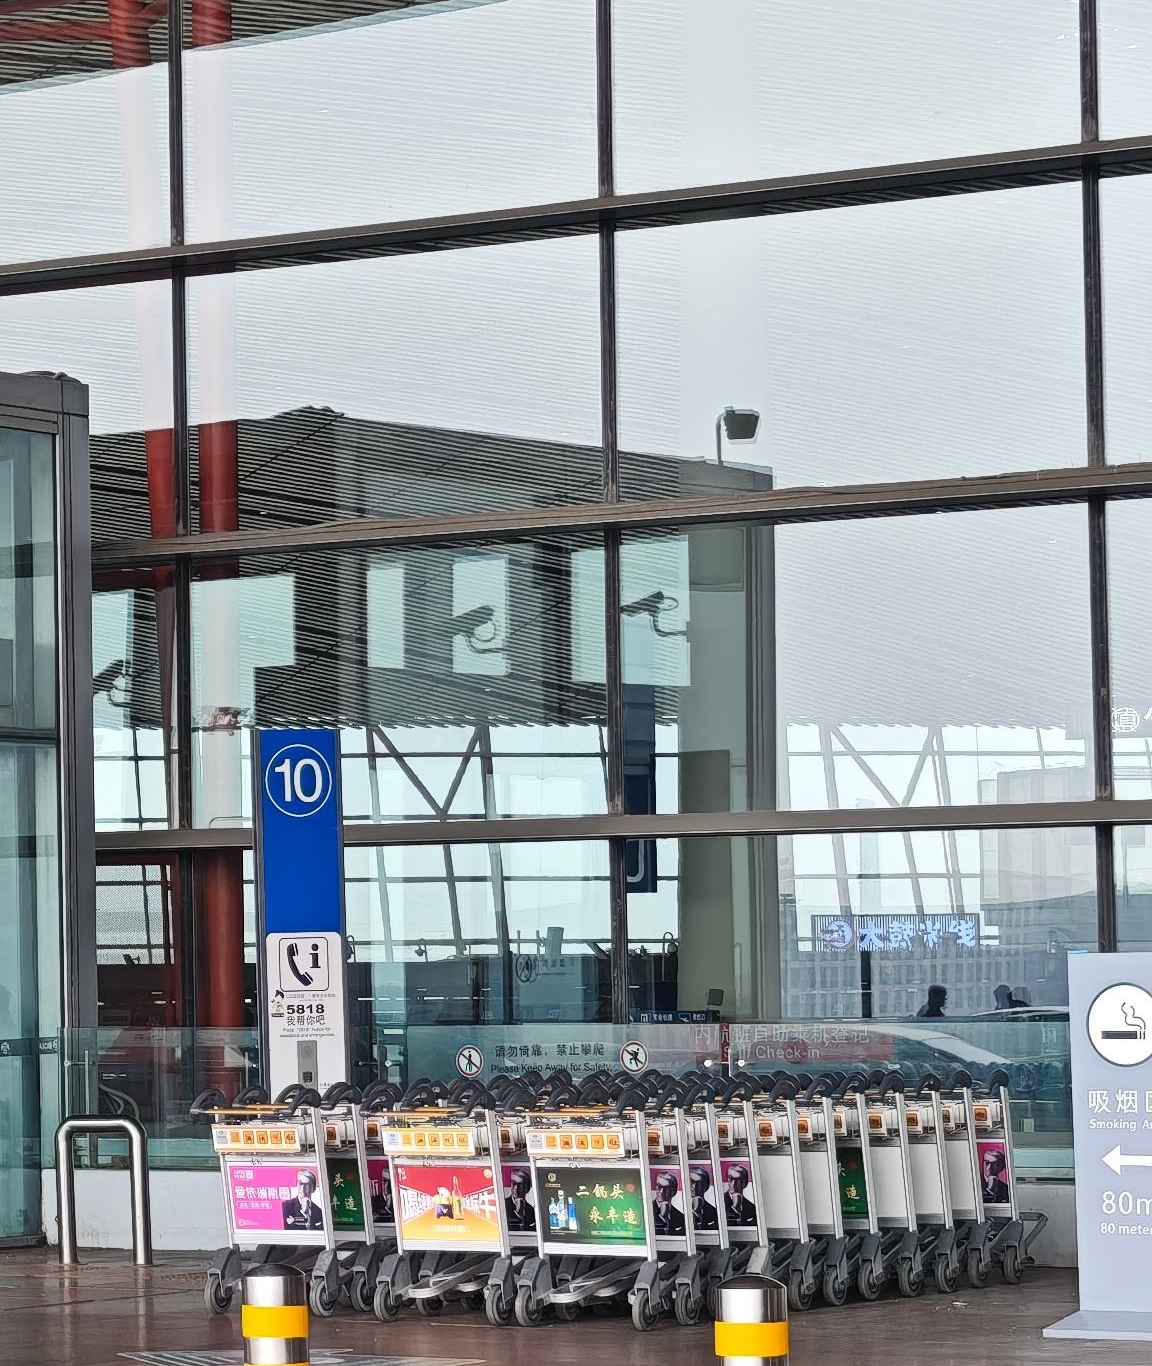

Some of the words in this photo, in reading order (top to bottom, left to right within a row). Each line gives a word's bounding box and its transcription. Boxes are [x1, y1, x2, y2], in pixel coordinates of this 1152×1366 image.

[274, 758, 323, 804] 10
[286, 1004, 325, 1015] 5818
[286, 1015, 326, 1026] 我帮你吧
[755, 1044, 821, 1060] Check-in
[491, 1063, 519, 1074] Please
[521, 1063, 544, 1074] Keep
[570, 1062, 582, 1072] for
[1089, 1118, 1137, 1132] Smoking
[576, 1183, 624, 1200] 二锅头
[1102, 1190, 1152, 1215] 80m
[1100, 1222, 1116, 1234] 80
